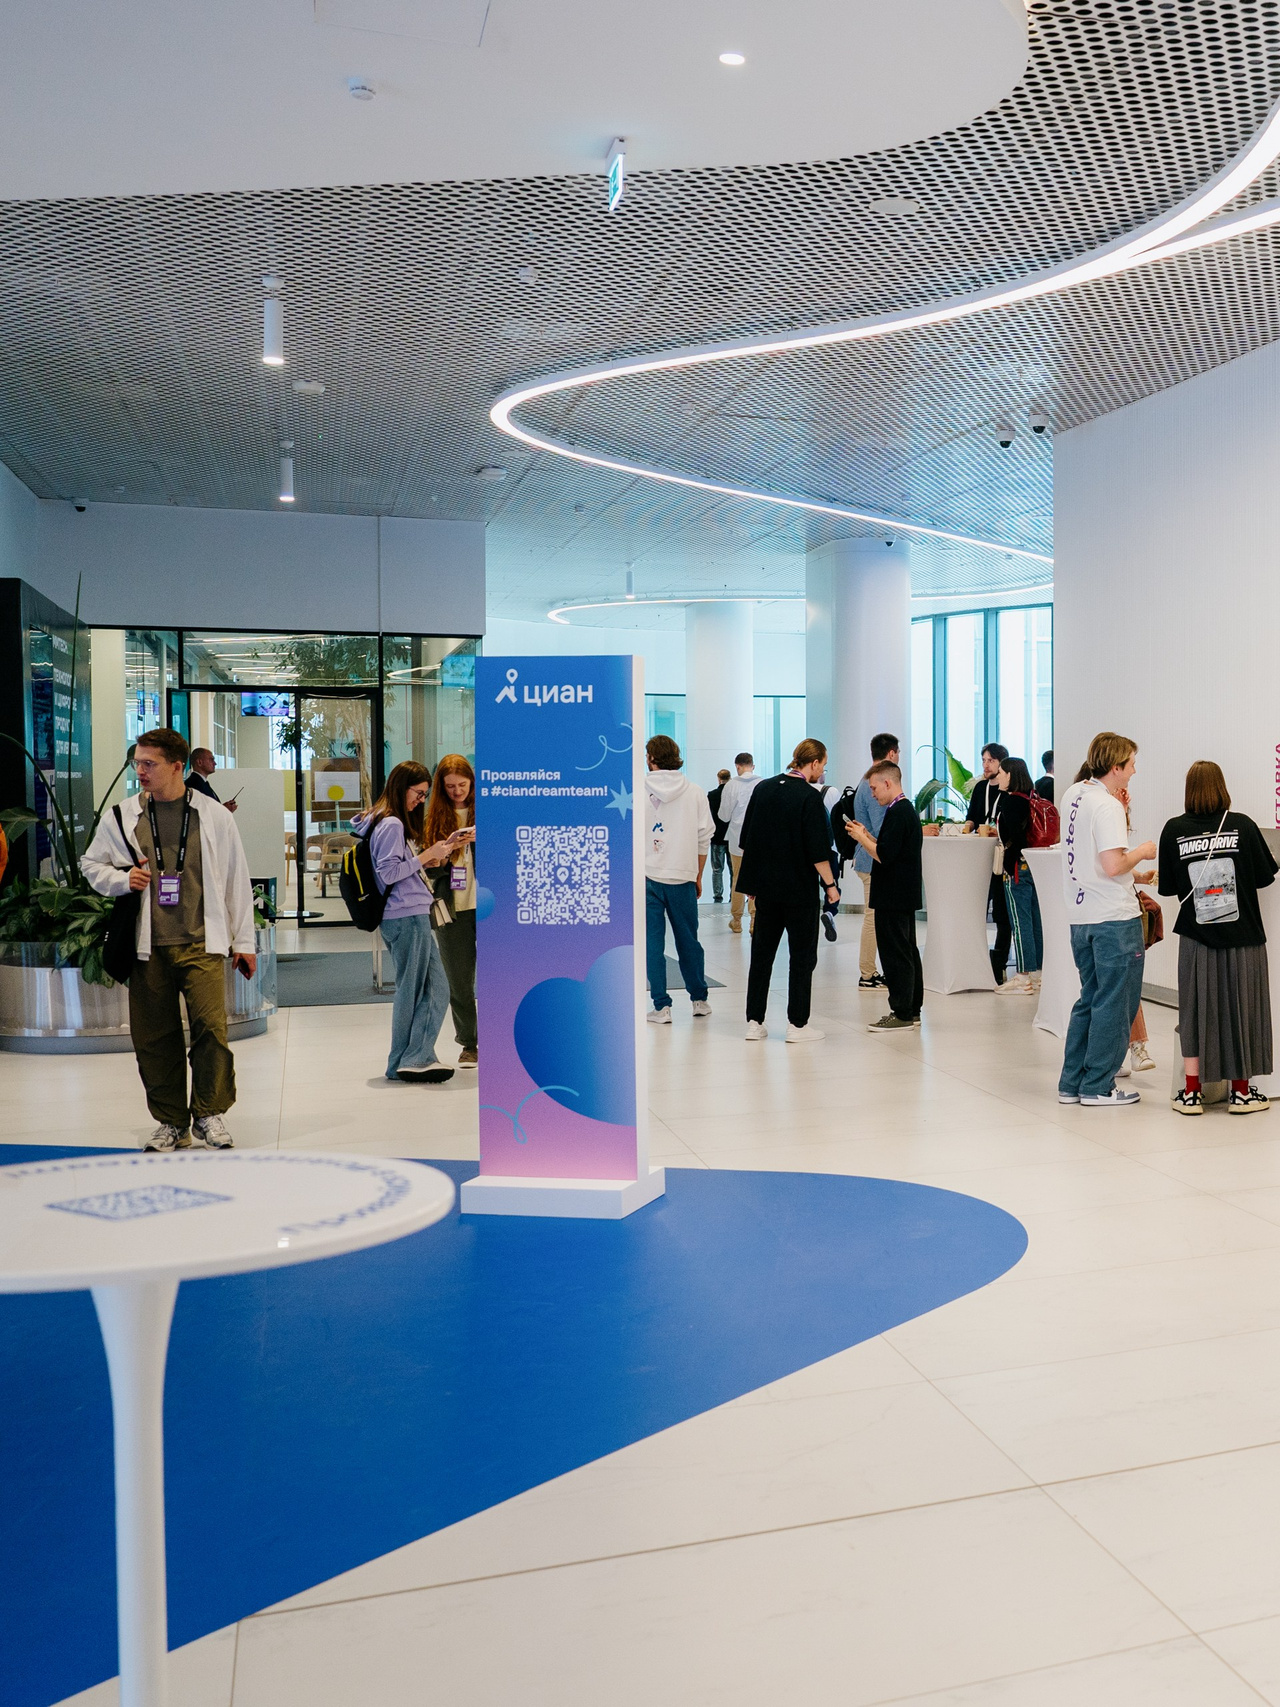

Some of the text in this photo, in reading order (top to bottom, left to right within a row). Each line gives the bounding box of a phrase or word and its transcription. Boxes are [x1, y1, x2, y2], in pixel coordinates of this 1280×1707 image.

[523, 684, 594, 707] циан
[481, 769, 561, 783] Проявляйся
[481, 785, 608, 797] в #ciandreamteam!
[1179, 836, 1239, 856] YANGO DRIVE
